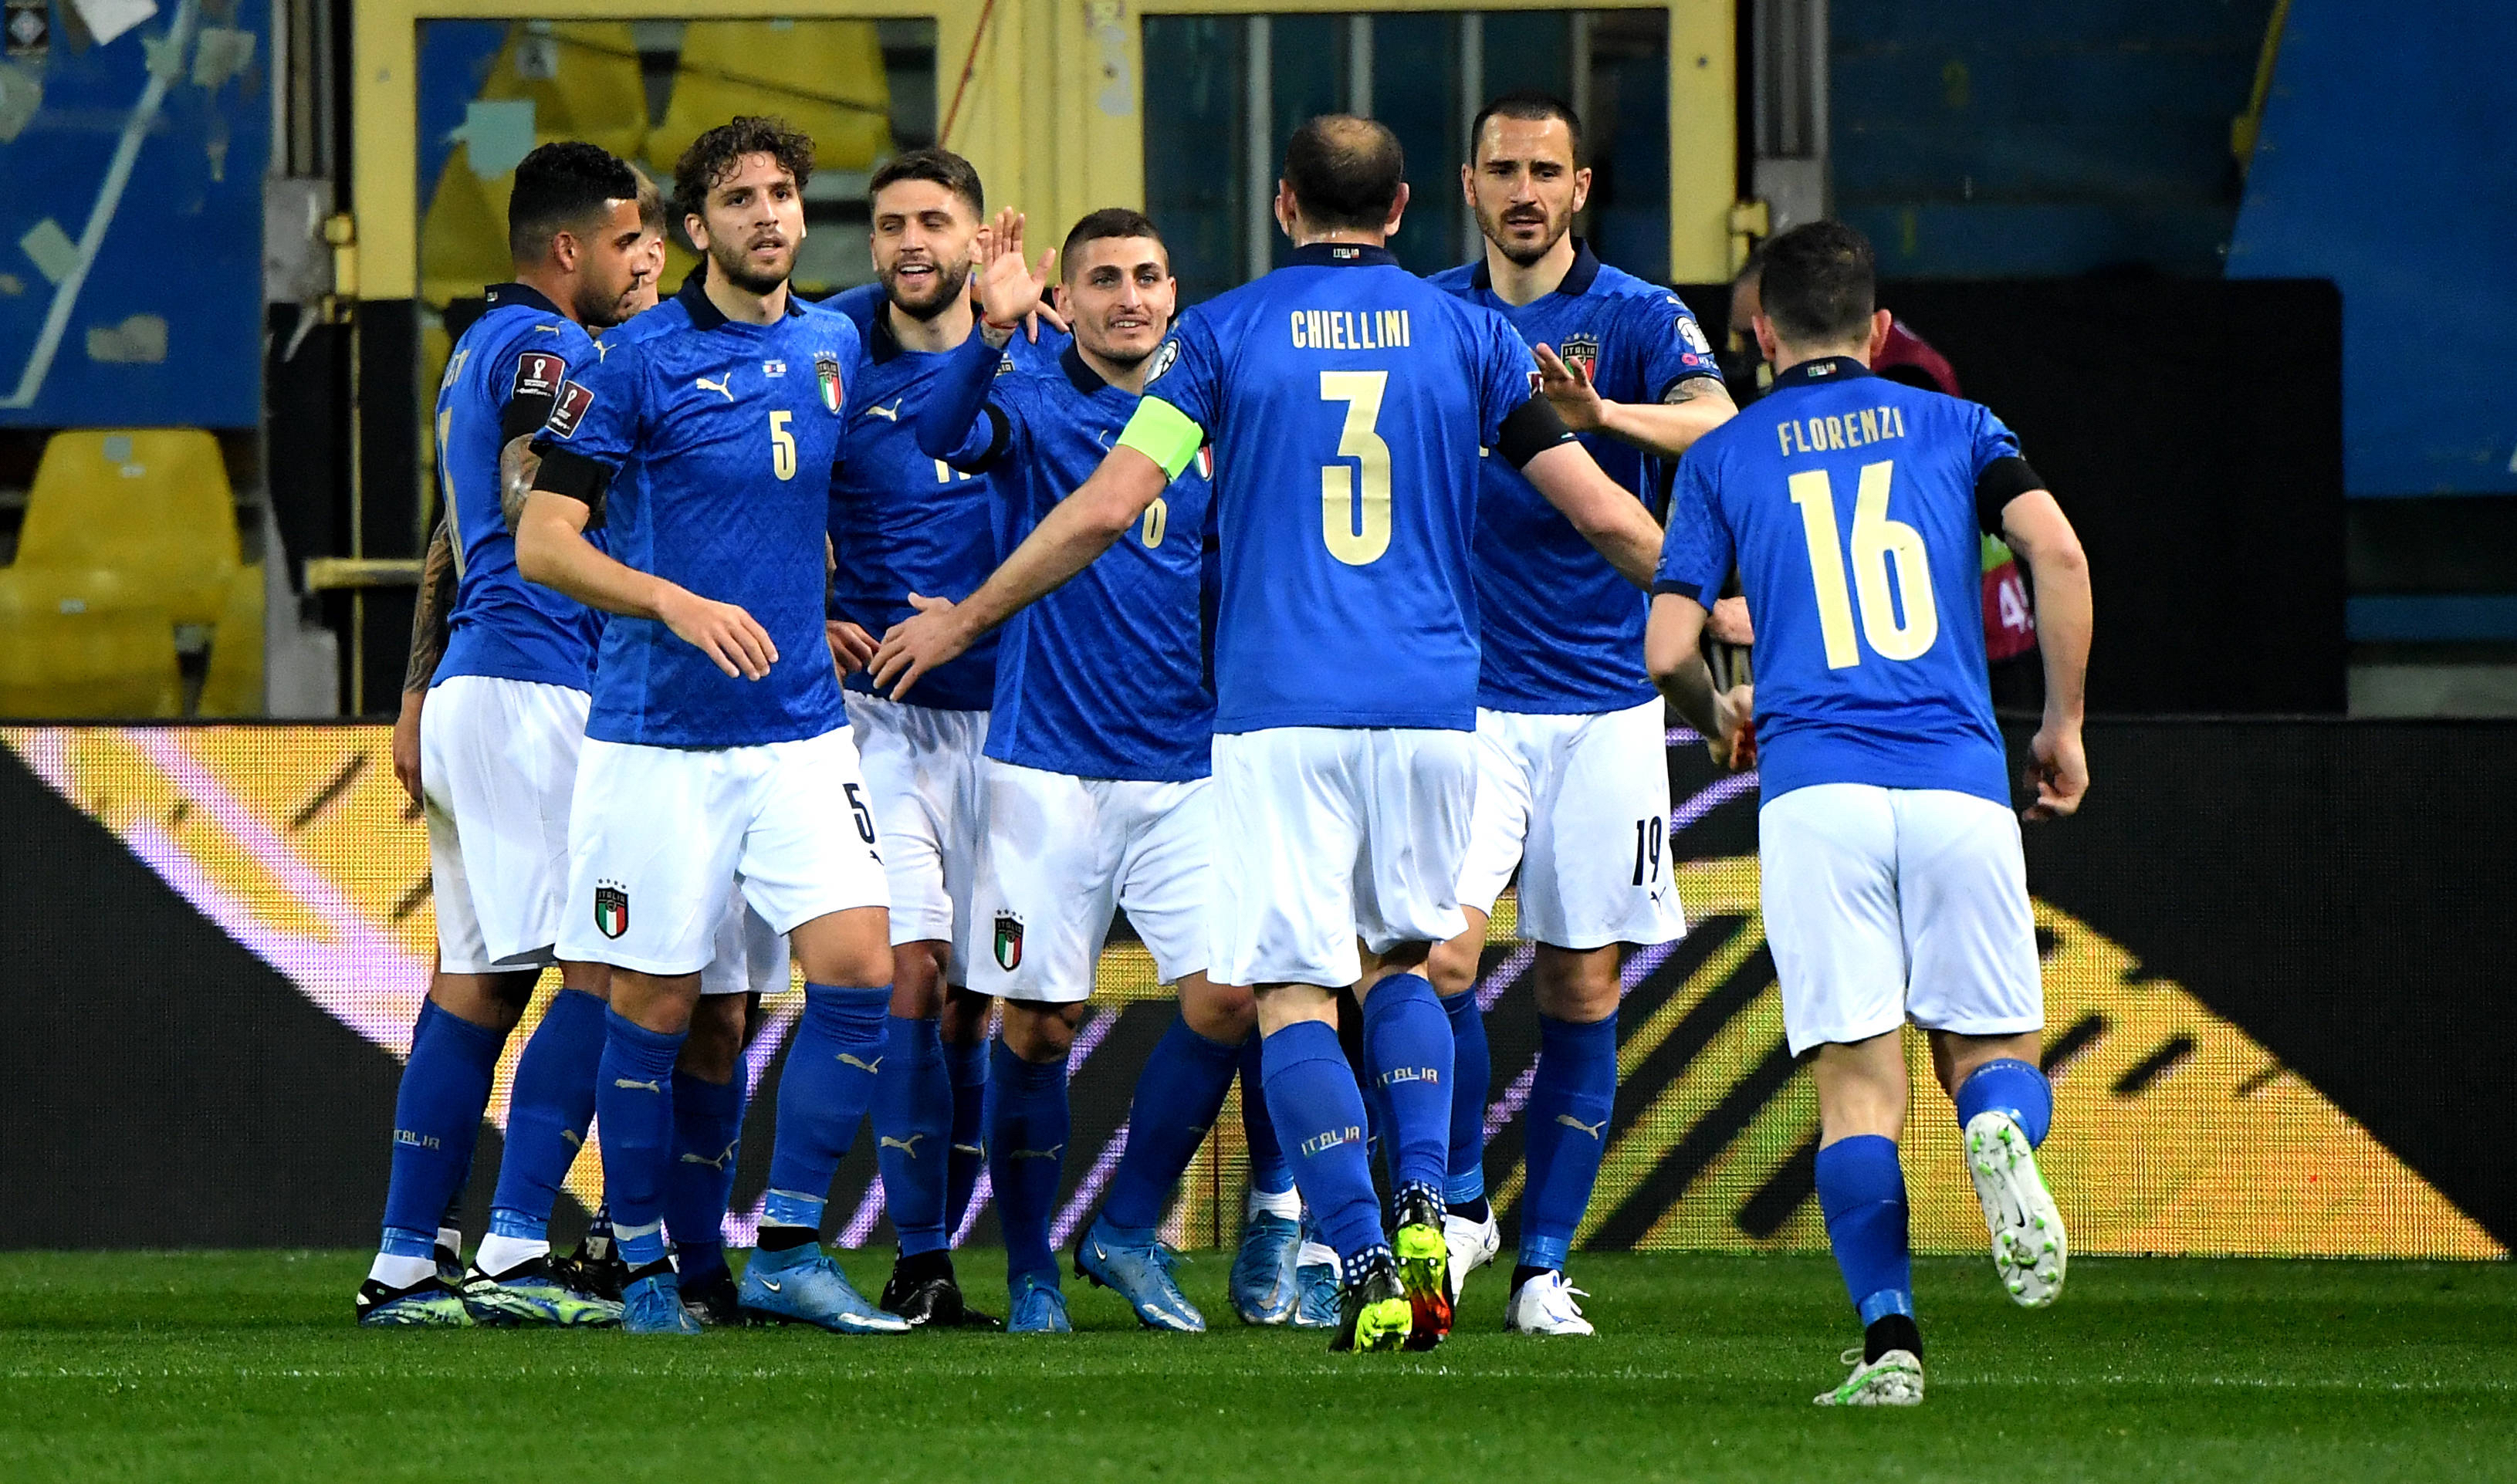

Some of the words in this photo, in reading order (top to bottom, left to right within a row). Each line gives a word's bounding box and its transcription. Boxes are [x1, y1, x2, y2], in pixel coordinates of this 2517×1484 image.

[1290, 309, 1411, 350] CHIELLINI
[1565, 346, 1595, 355] ITALIA
[769, 410, 797, 482] 5
[1777, 407, 1905, 457] FLORENZI
[1319, 370, 1392, 566] 3
[1788, 460, 1939, 670] 16
[842, 783, 876, 844] 5
[1632, 815, 1662, 886] 19
[598, 891, 626, 902] ITALIA
[1377, 1067, 1439, 1087] ITALIA
[1301, 1126, 1360, 1158] ITALIA
